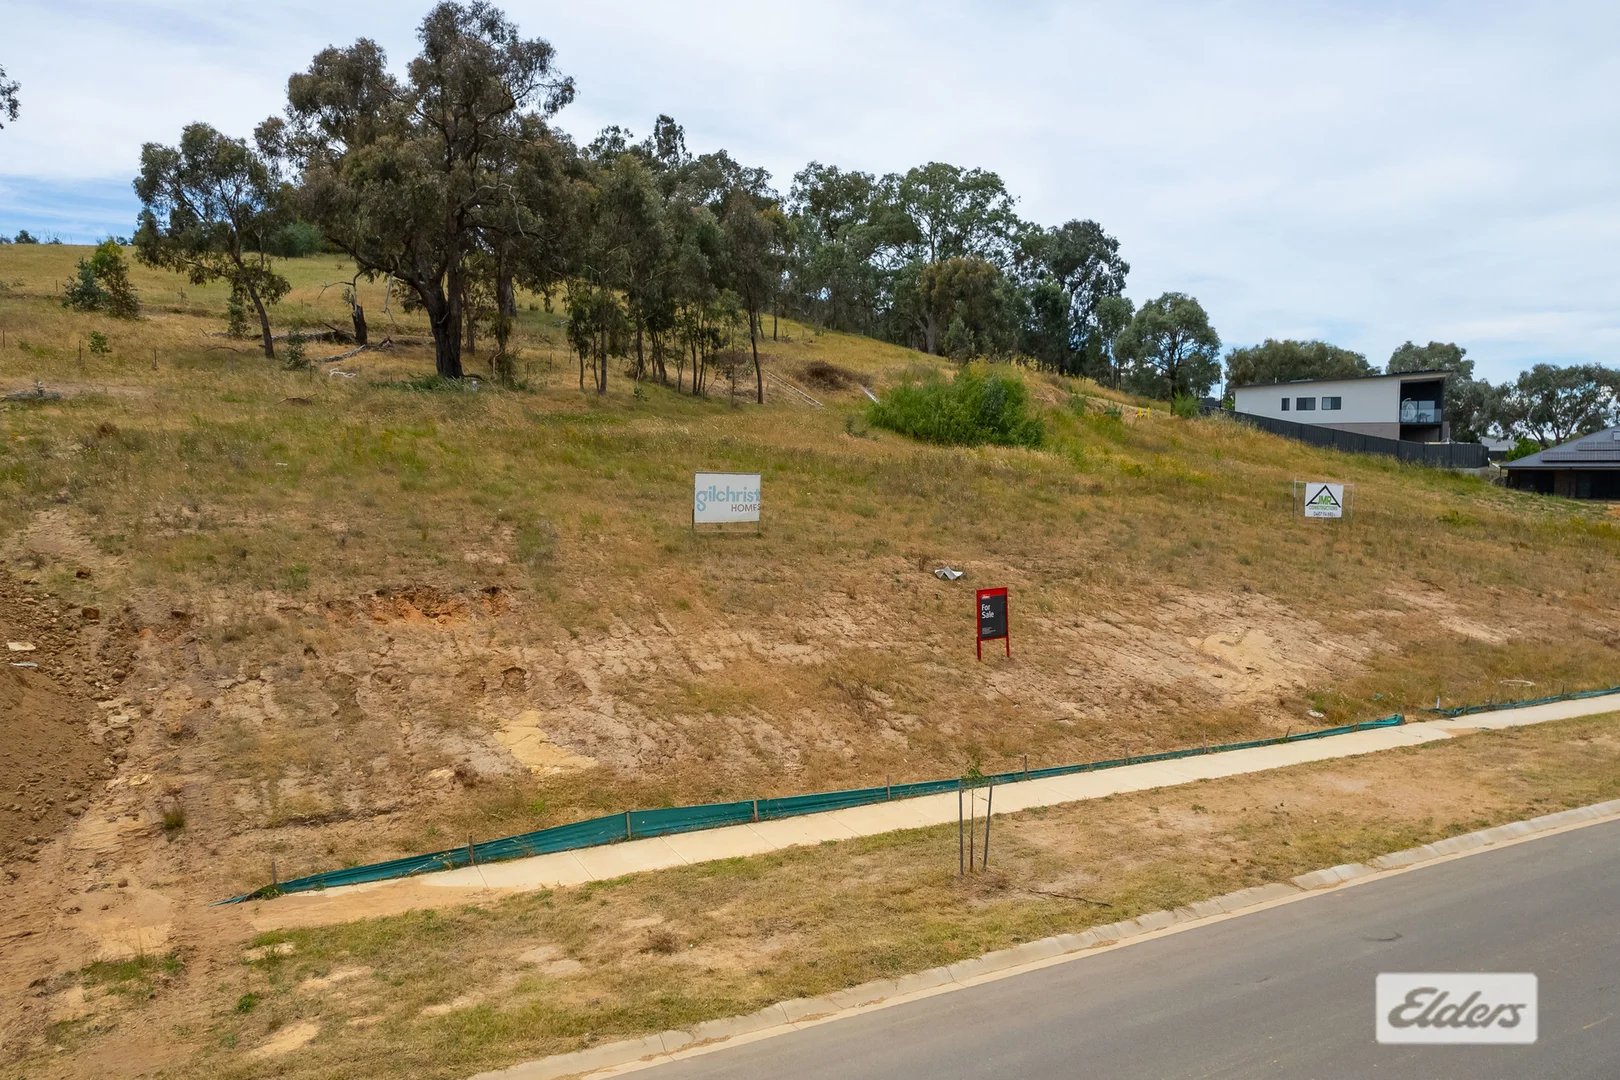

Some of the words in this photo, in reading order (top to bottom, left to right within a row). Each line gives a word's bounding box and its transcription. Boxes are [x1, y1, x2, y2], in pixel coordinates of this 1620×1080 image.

[696, 485, 760, 512] gilchrist
[981, 603, 991, 611] For
[981, 611, 994, 619] Sale
